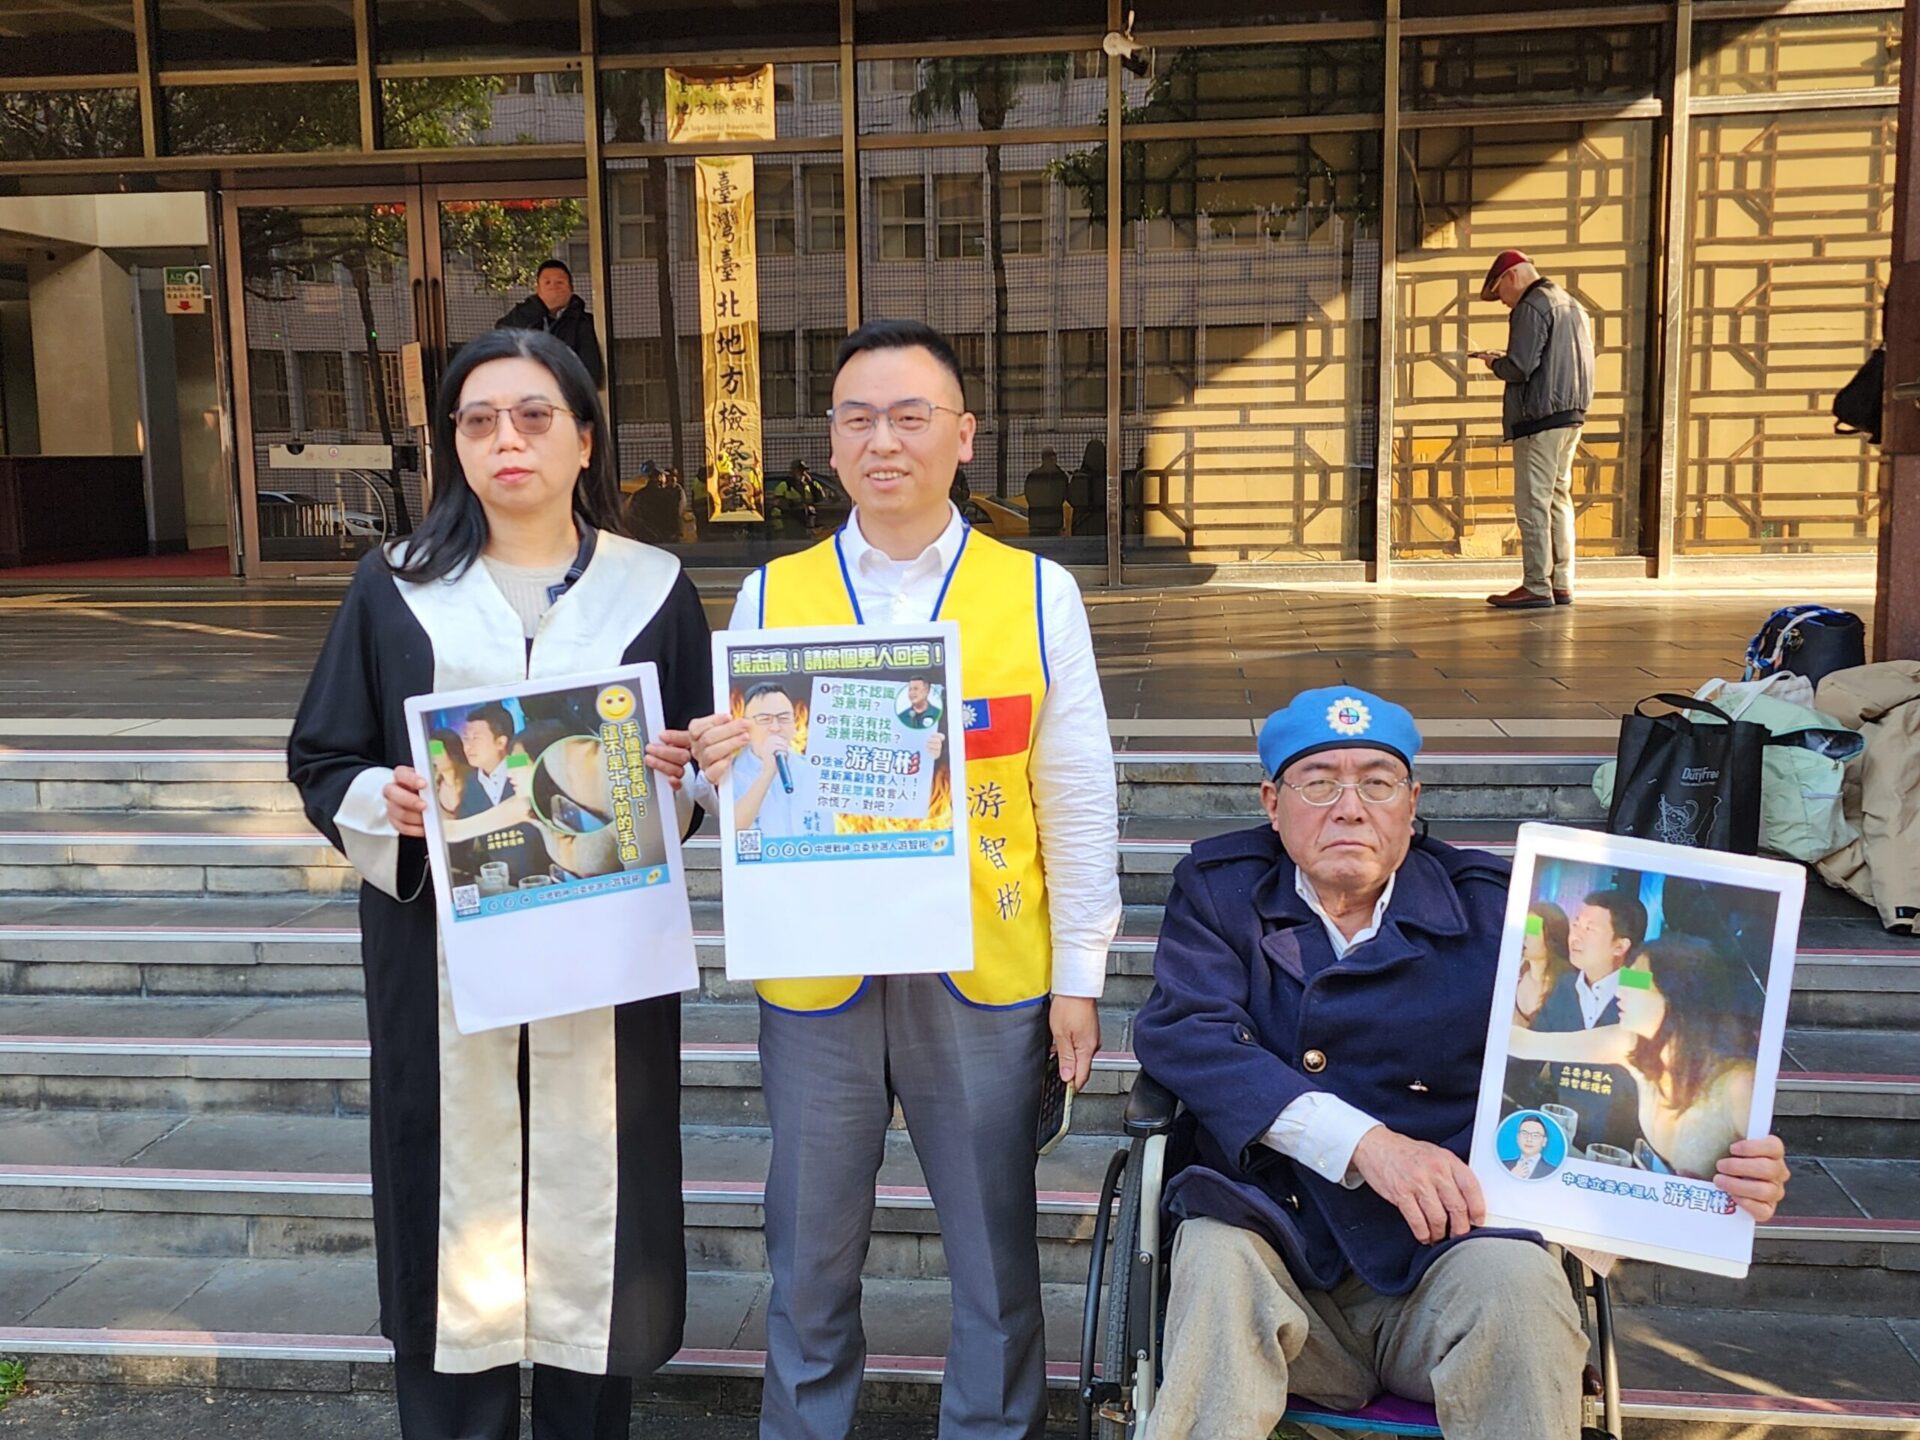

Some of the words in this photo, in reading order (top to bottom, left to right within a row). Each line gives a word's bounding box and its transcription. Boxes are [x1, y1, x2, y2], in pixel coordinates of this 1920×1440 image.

[676, 97, 765, 115] 地方檢察署
[711, 170, 750, 513] 臺灣臺北地方檢察署
[966, 781, 1022, 921] 游智彬
